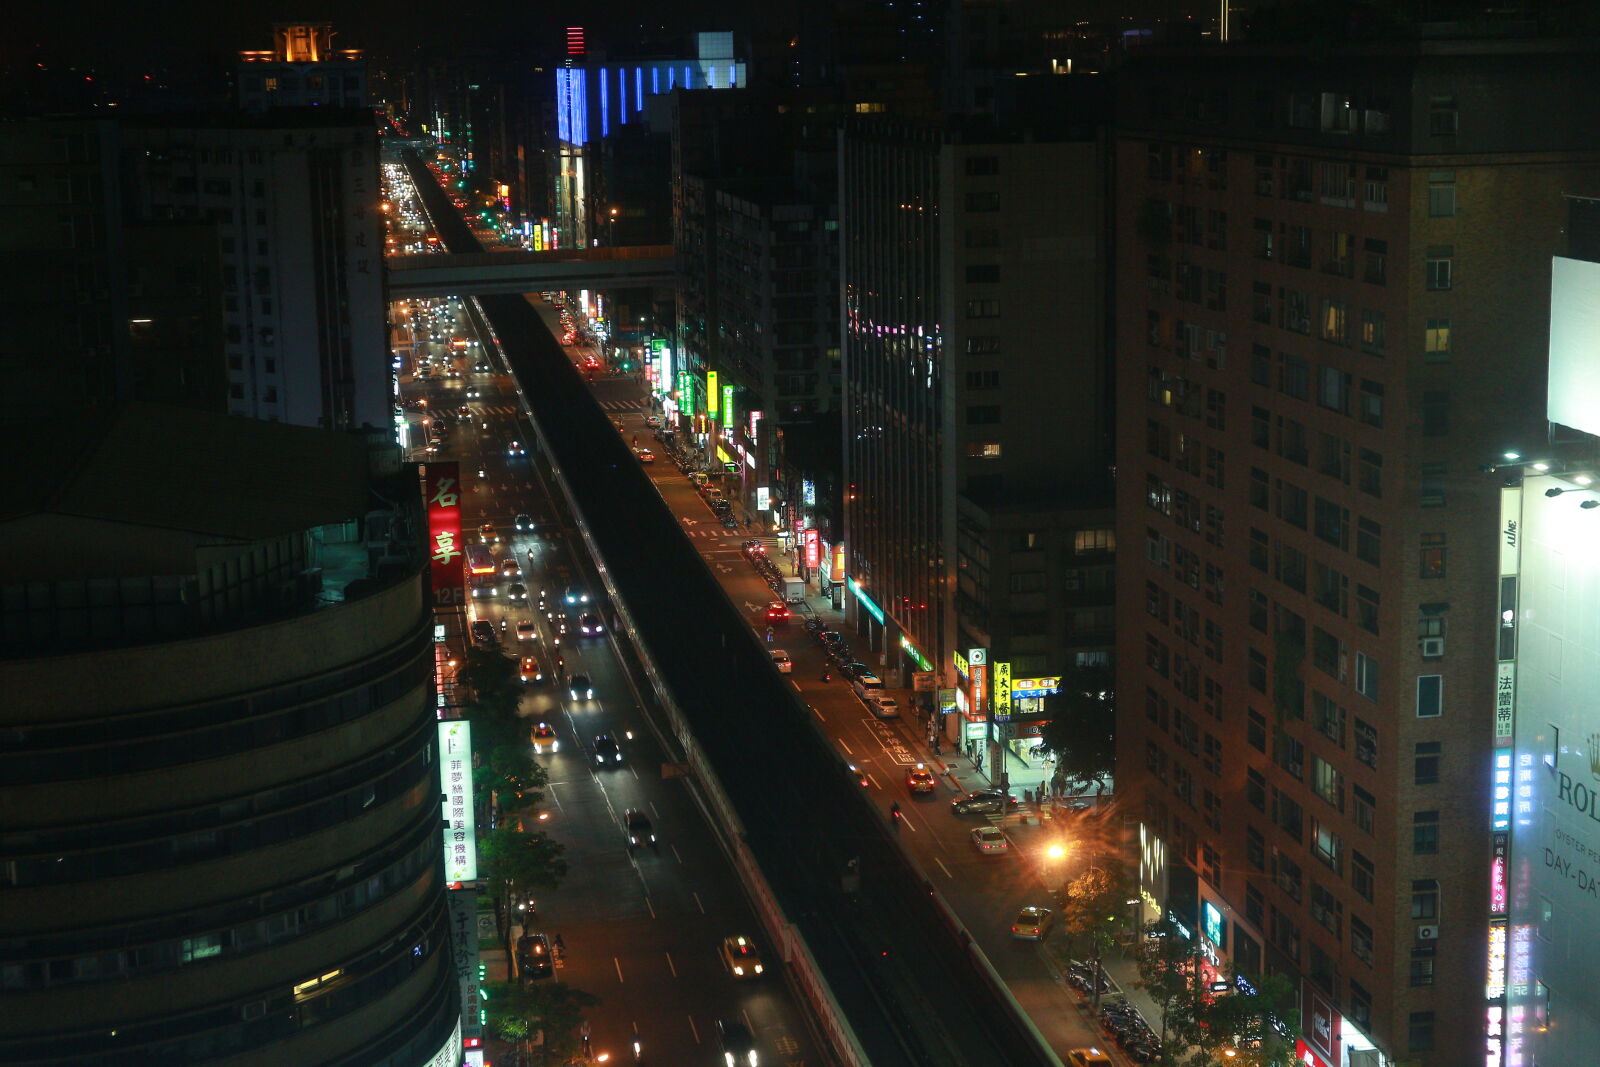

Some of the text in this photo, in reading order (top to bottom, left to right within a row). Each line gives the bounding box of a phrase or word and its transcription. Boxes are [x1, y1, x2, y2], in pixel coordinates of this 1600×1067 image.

[431, 477, 461, 565] 名享
[434, 588, 464, 604] 12F
[1498, 676, 1512, 722] 法蕾蒂
[1555, 829, 1586, 856] OYSTER
